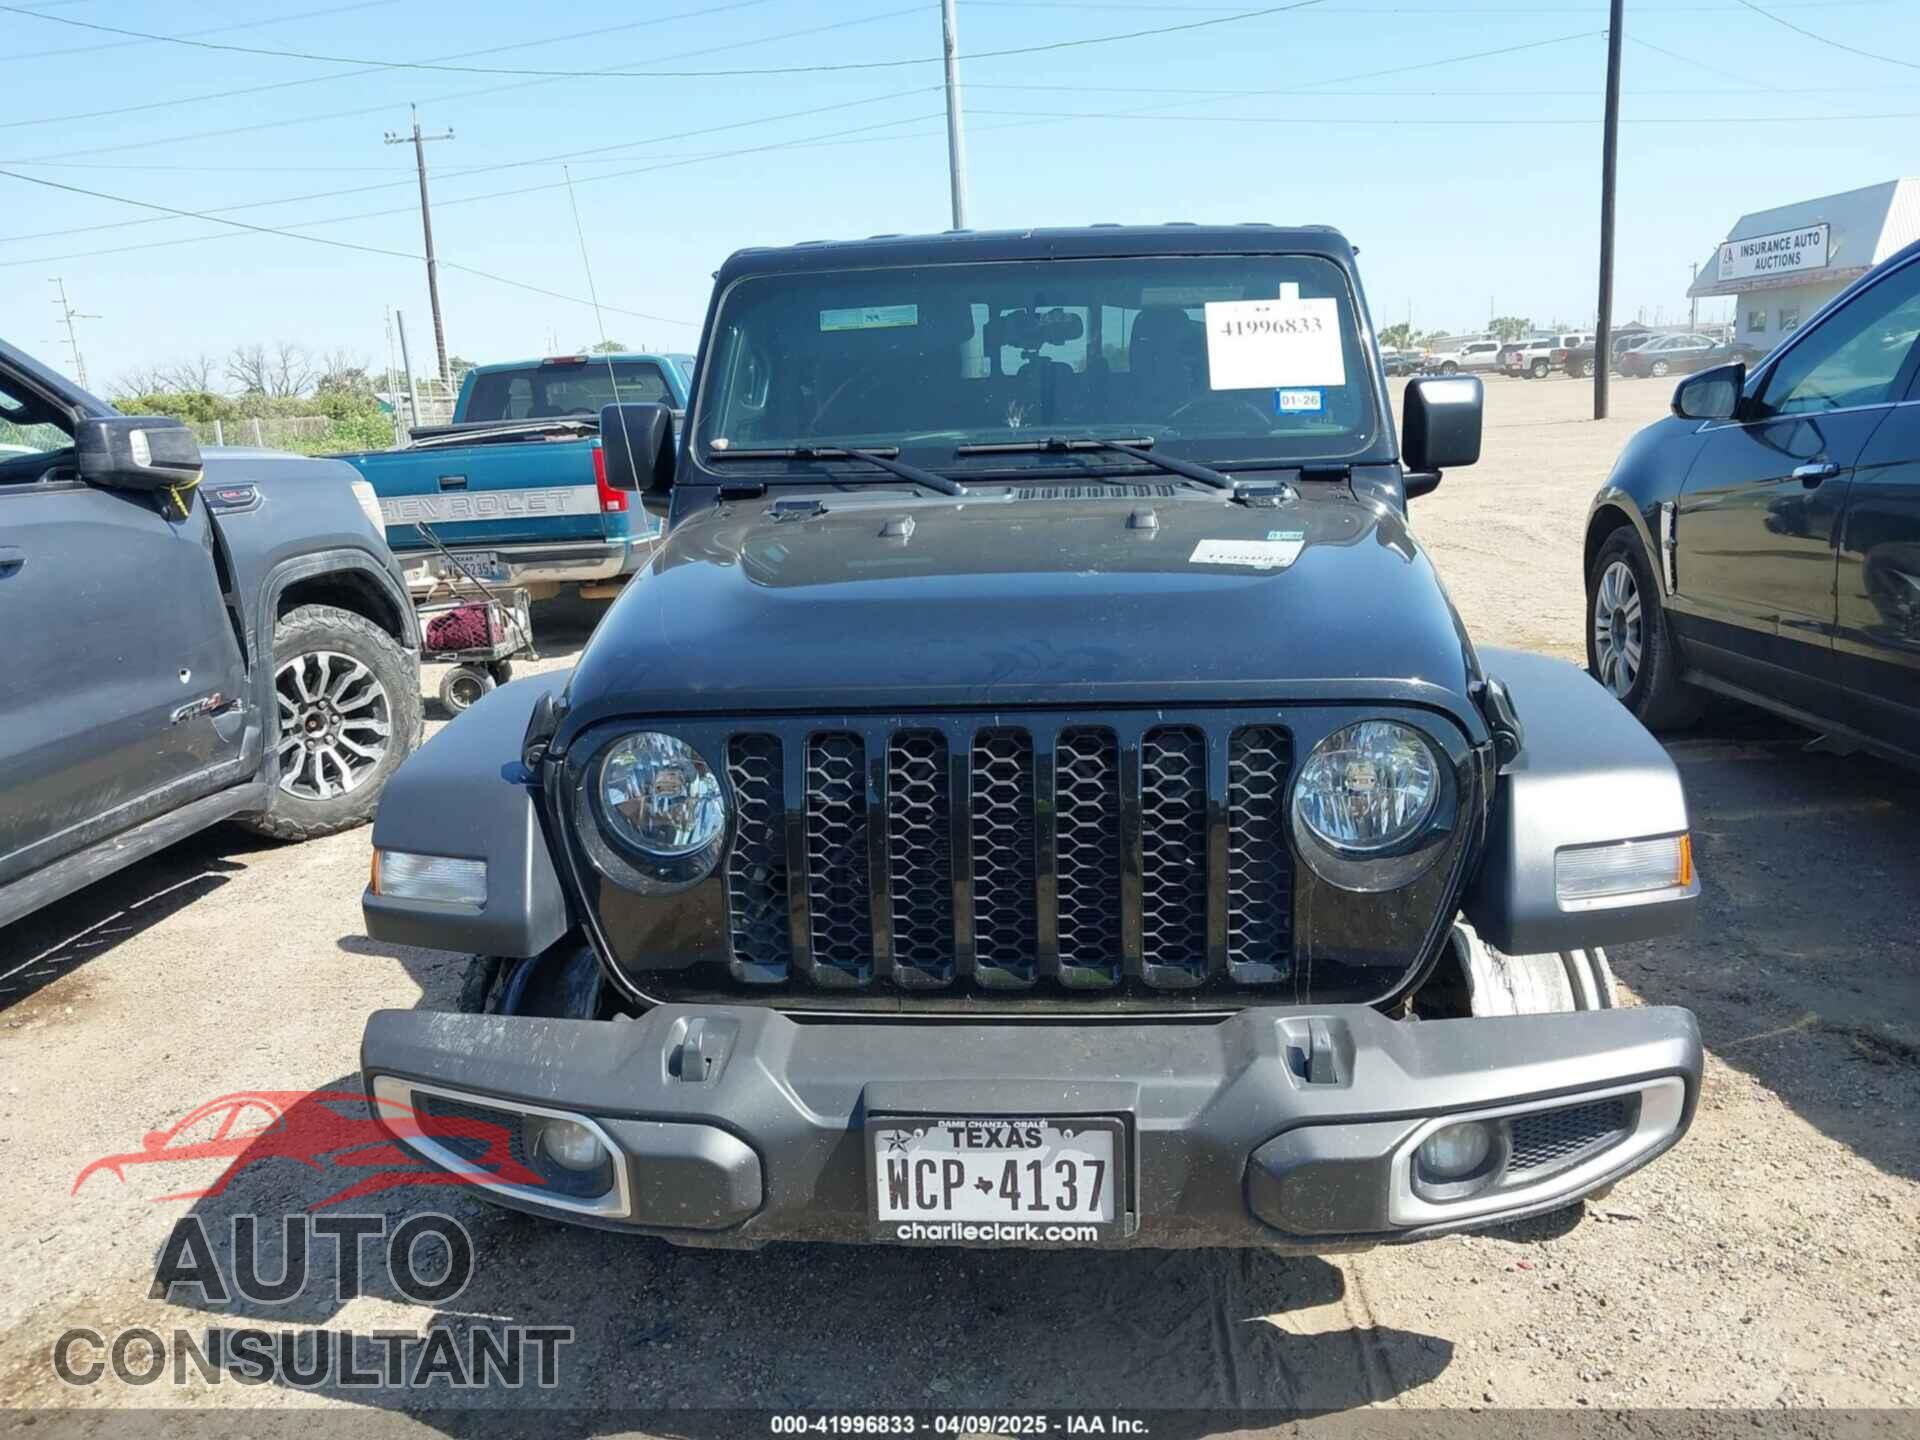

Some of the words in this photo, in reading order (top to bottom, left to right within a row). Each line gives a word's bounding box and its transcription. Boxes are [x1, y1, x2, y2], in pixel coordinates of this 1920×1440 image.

[1741, 237, 1791, 257] INSURANCE
[1794, 231, 1821, 248] AUTO
[1755, 252, 1801, 270] AUCTIONS
[1220, 317, 1322, 336] 41996833
[381, 490, 573, 521] HEVROLET
[949, 1128, 1043, 1148] TEXAS
[887, 1159, 964, 1210] WCP
[1000, 1159, 1105, 1212] 4137
[897, 1222, 1098, 1242] charlieclark.com
